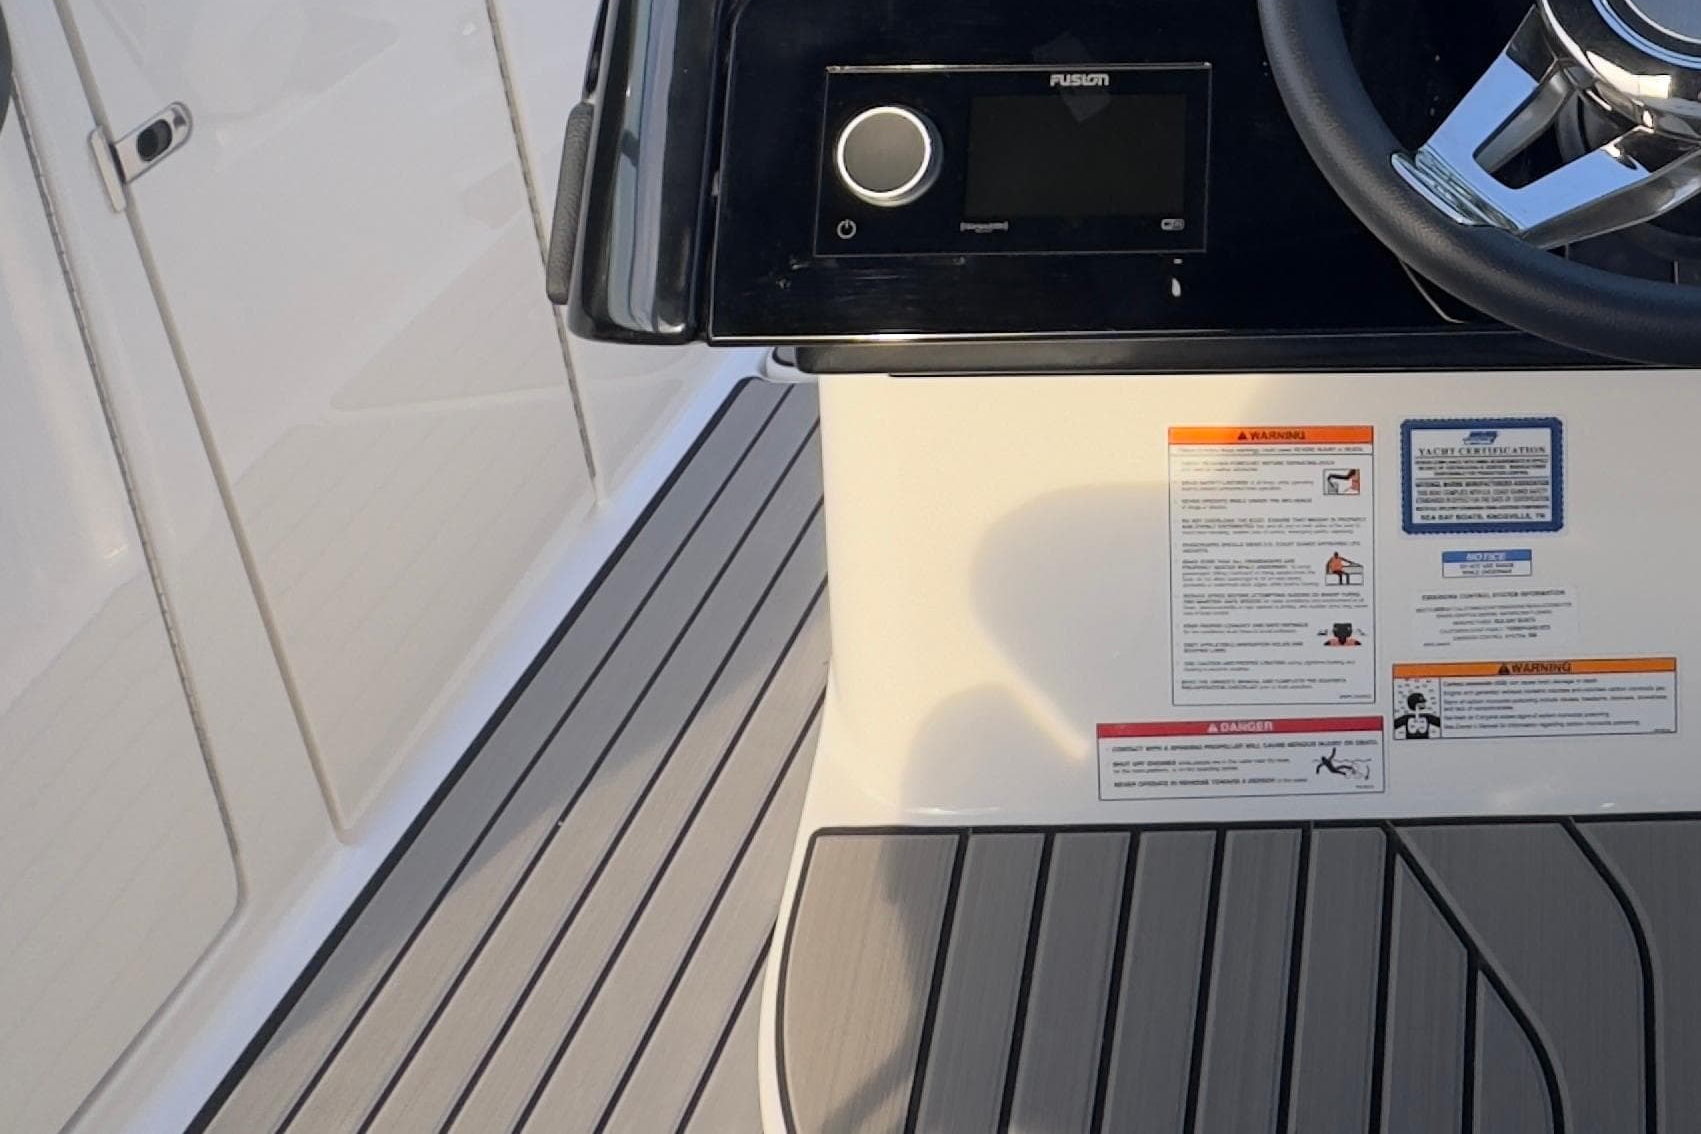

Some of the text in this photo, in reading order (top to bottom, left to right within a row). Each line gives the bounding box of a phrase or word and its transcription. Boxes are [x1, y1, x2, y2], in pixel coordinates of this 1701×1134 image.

[1050, 73, 1110, 87] FUSION
[1250, 430, 1306, 441] WARNING
[1419, 446, 1546, 456] YACHT CERTIFICATION
[1511, 662, 1572, 674] WARNING
[1219, 721, 1273, 733] DANGER
